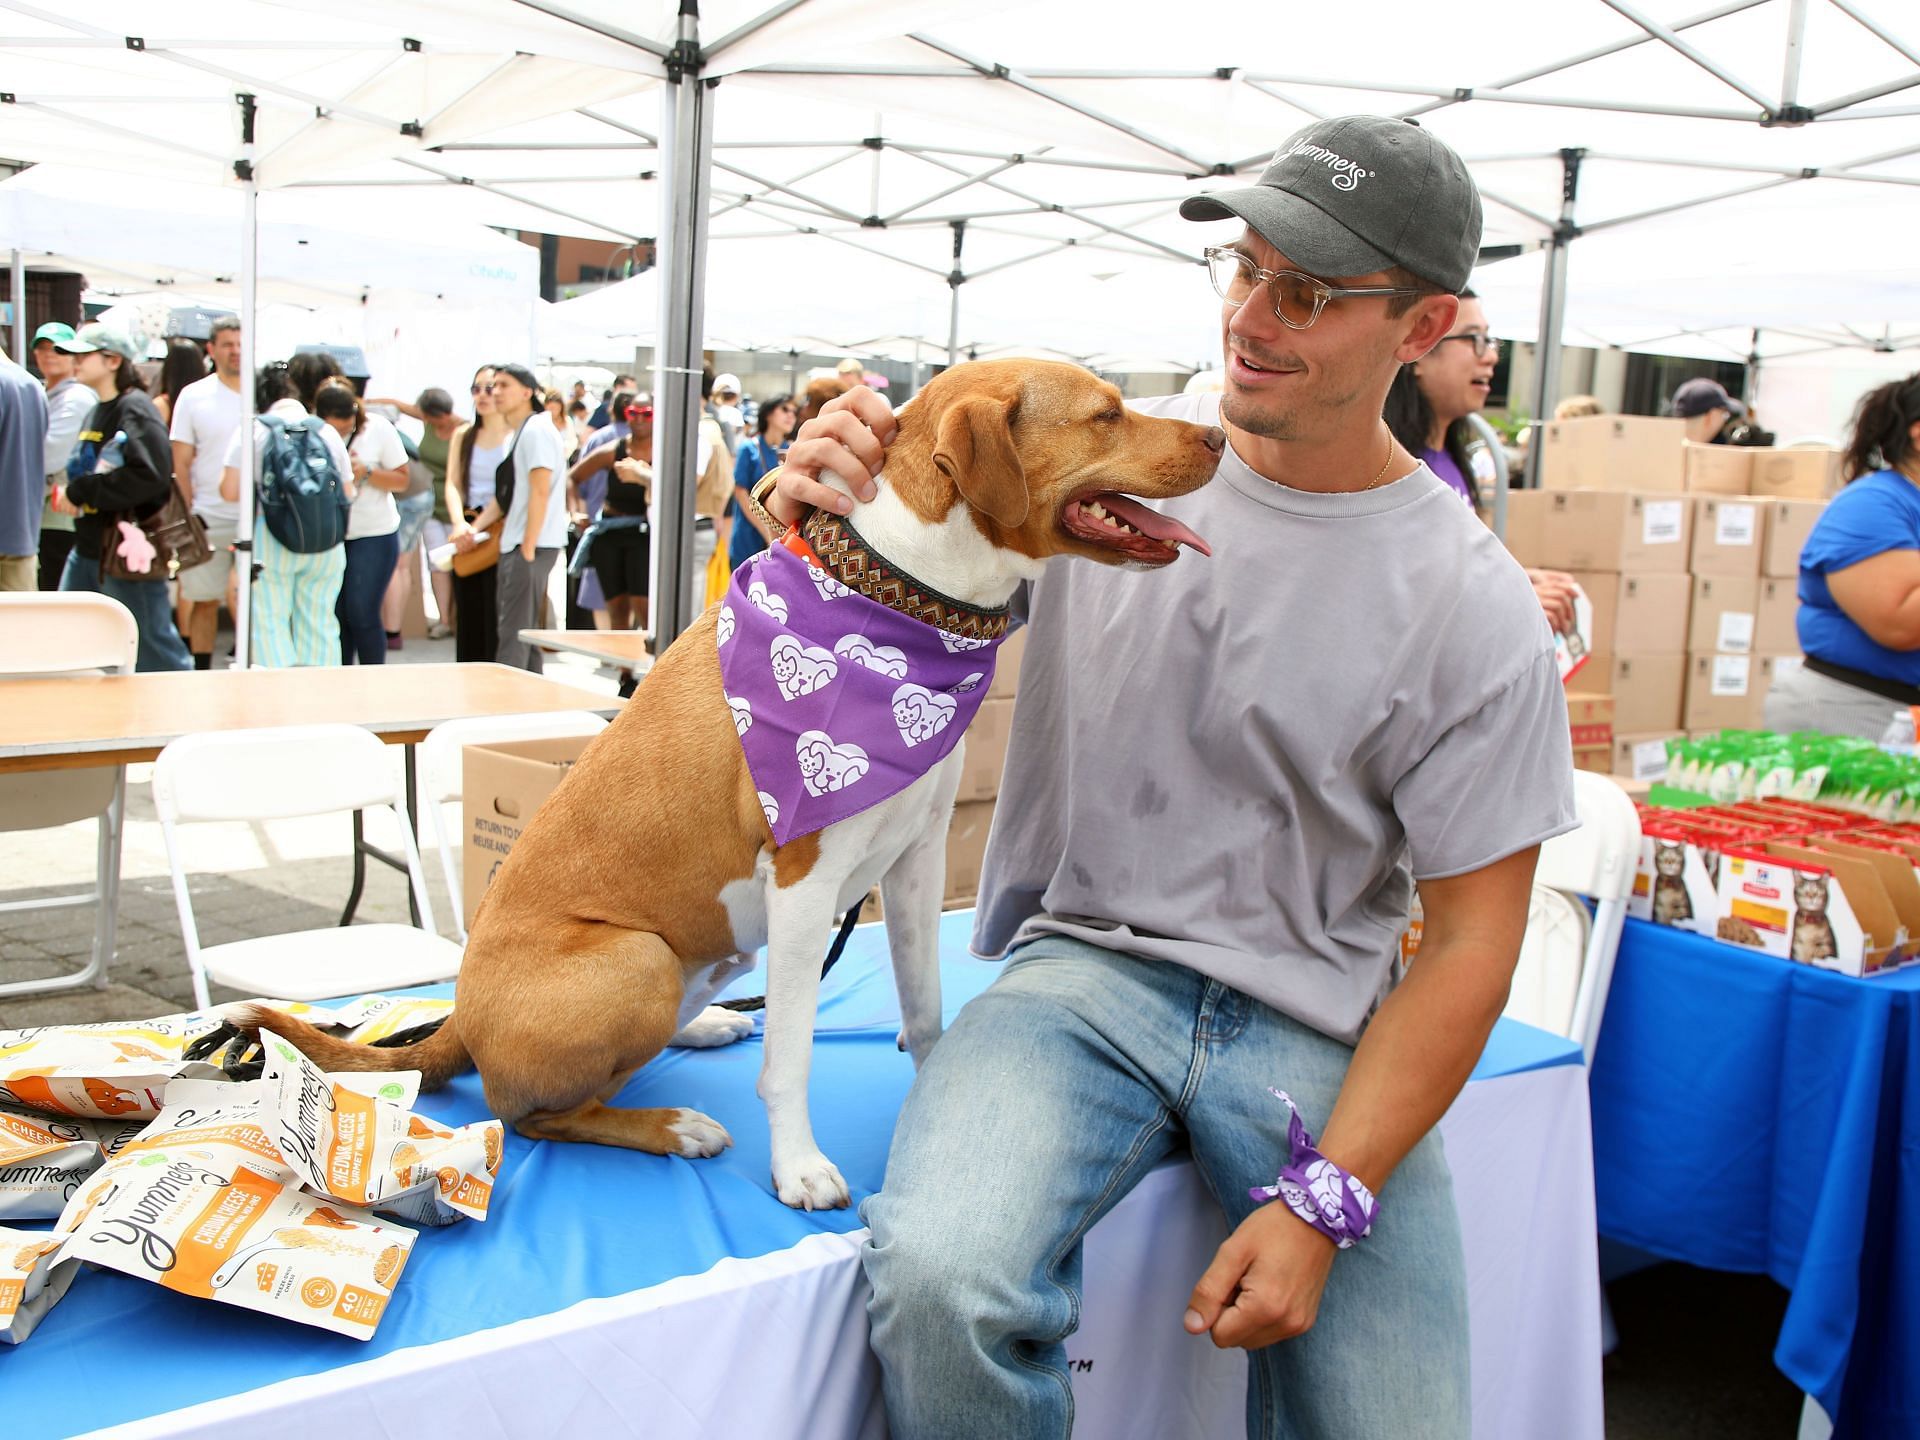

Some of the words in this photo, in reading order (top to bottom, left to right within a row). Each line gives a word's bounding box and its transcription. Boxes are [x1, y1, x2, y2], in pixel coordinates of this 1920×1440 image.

[1271, 136, 1366, 192] Yummers
[473, 833, 495, 851] REUSE
[475, 817, 502, 835] RETURN
[503, 825, 514, 839] TO
[280, 1059, 336, 1191] Yummers
[351, 1151, 364, 1186] OURMET
[0, 1165, 89, 1203] ummers
[455, 1180, 472, 1200] 40
[89, 1162, 232, 1272] Yummers
[217, 1187, 250, 1217] CHEESE
[340, 1291, 359, 1314] 40
[1068, 1359, 1093, 1372] TM
